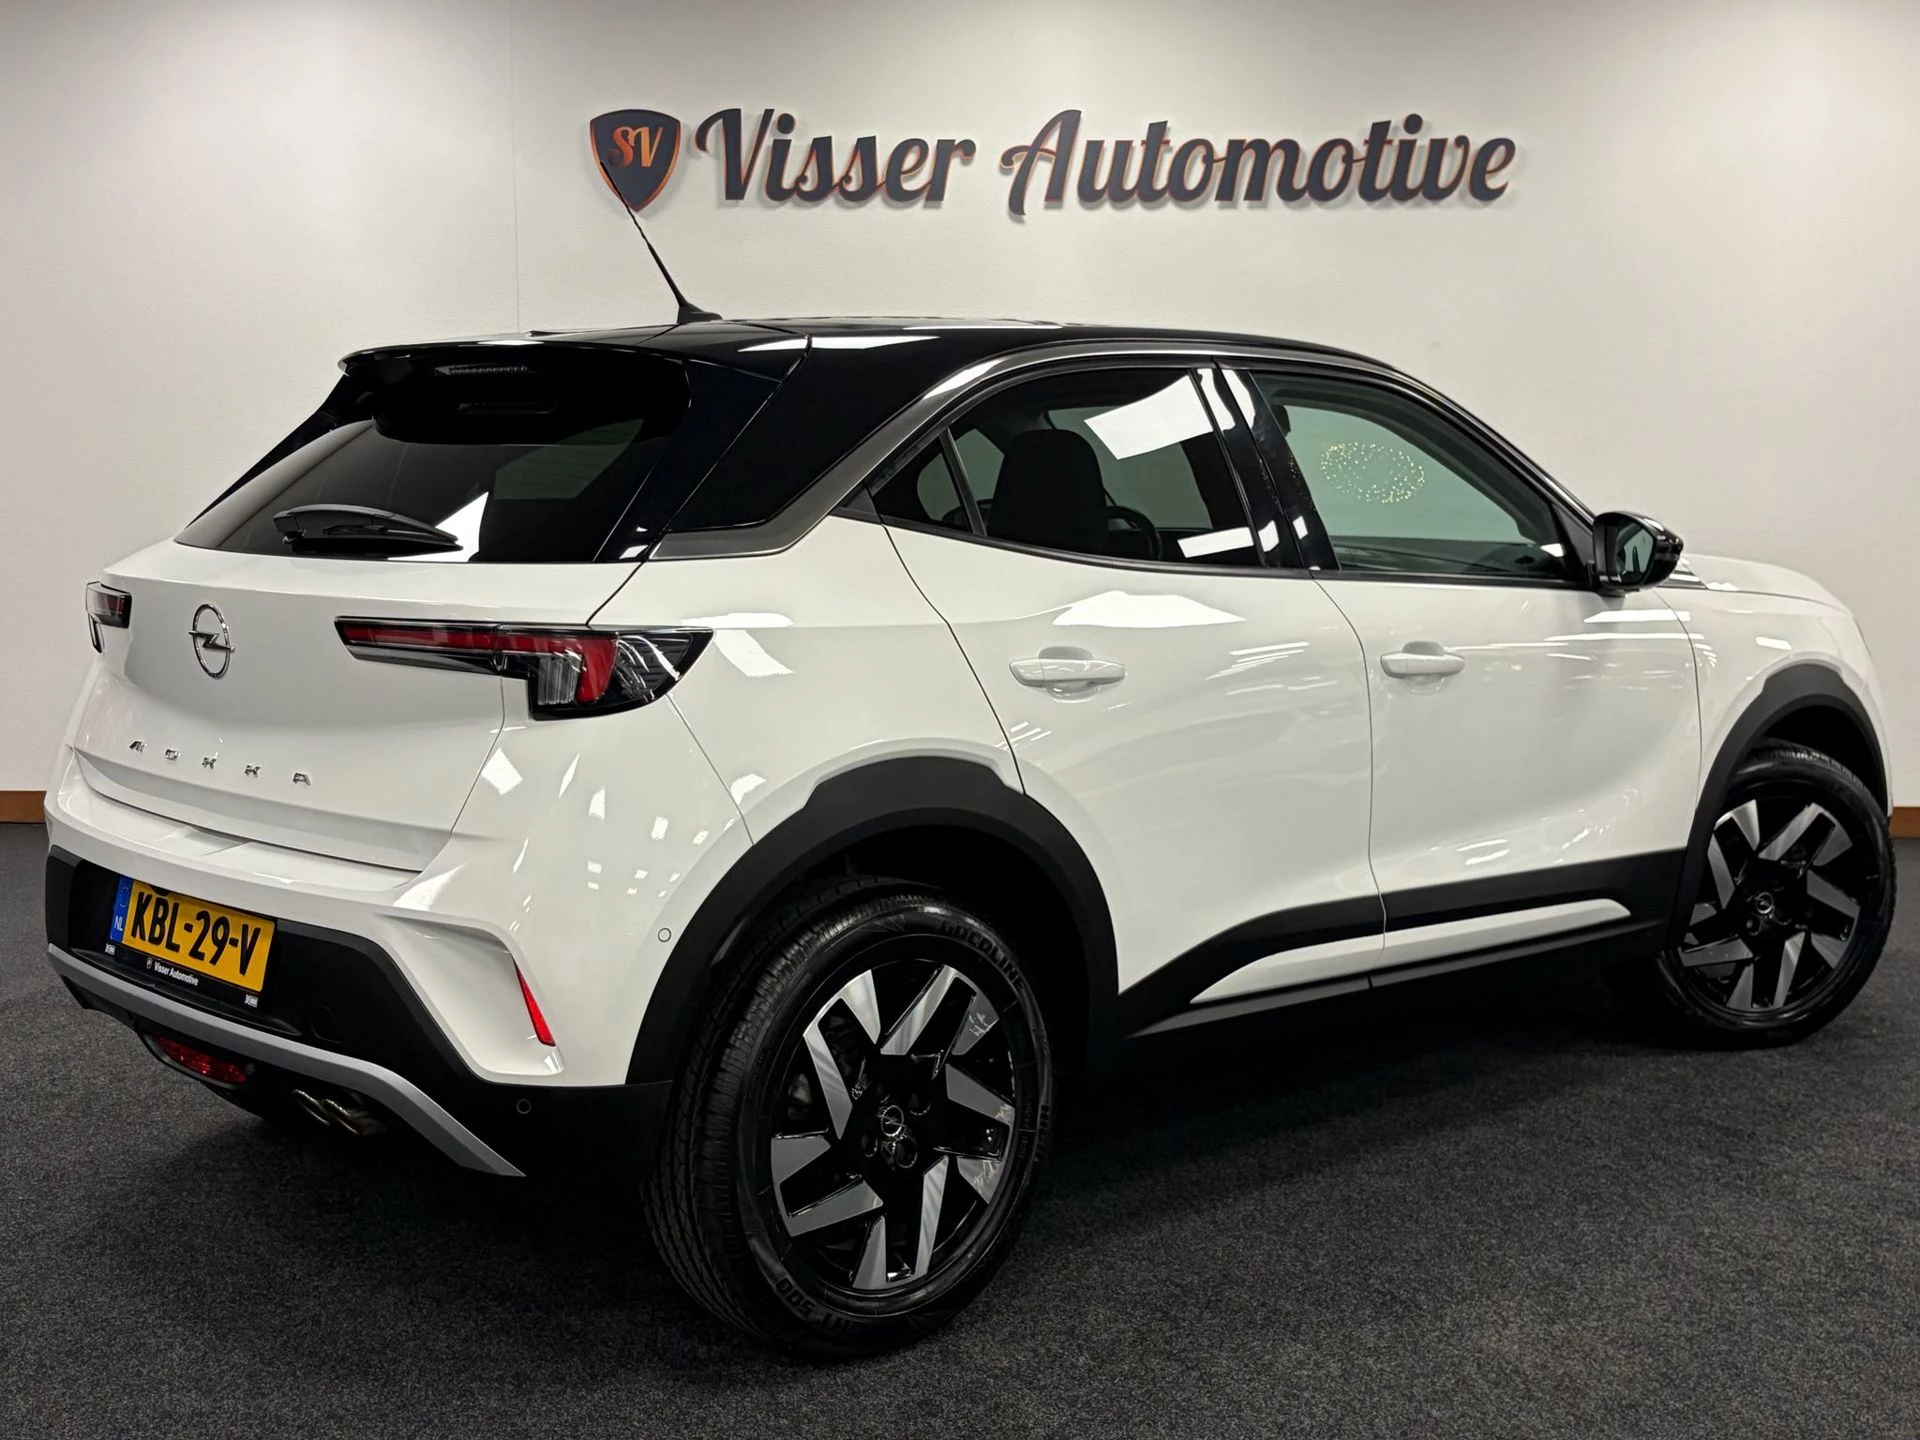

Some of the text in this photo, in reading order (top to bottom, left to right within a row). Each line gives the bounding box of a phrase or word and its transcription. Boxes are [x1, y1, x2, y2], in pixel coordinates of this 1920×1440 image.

[608, 126, 664, 168] SV
[695, 108, 1516, 216] Visser Automotive
[114, 914, 124, 931] NL
[130, 890, 262, 976] KBL-29-V
[154, 961, 199, 986] Visser Automotive
